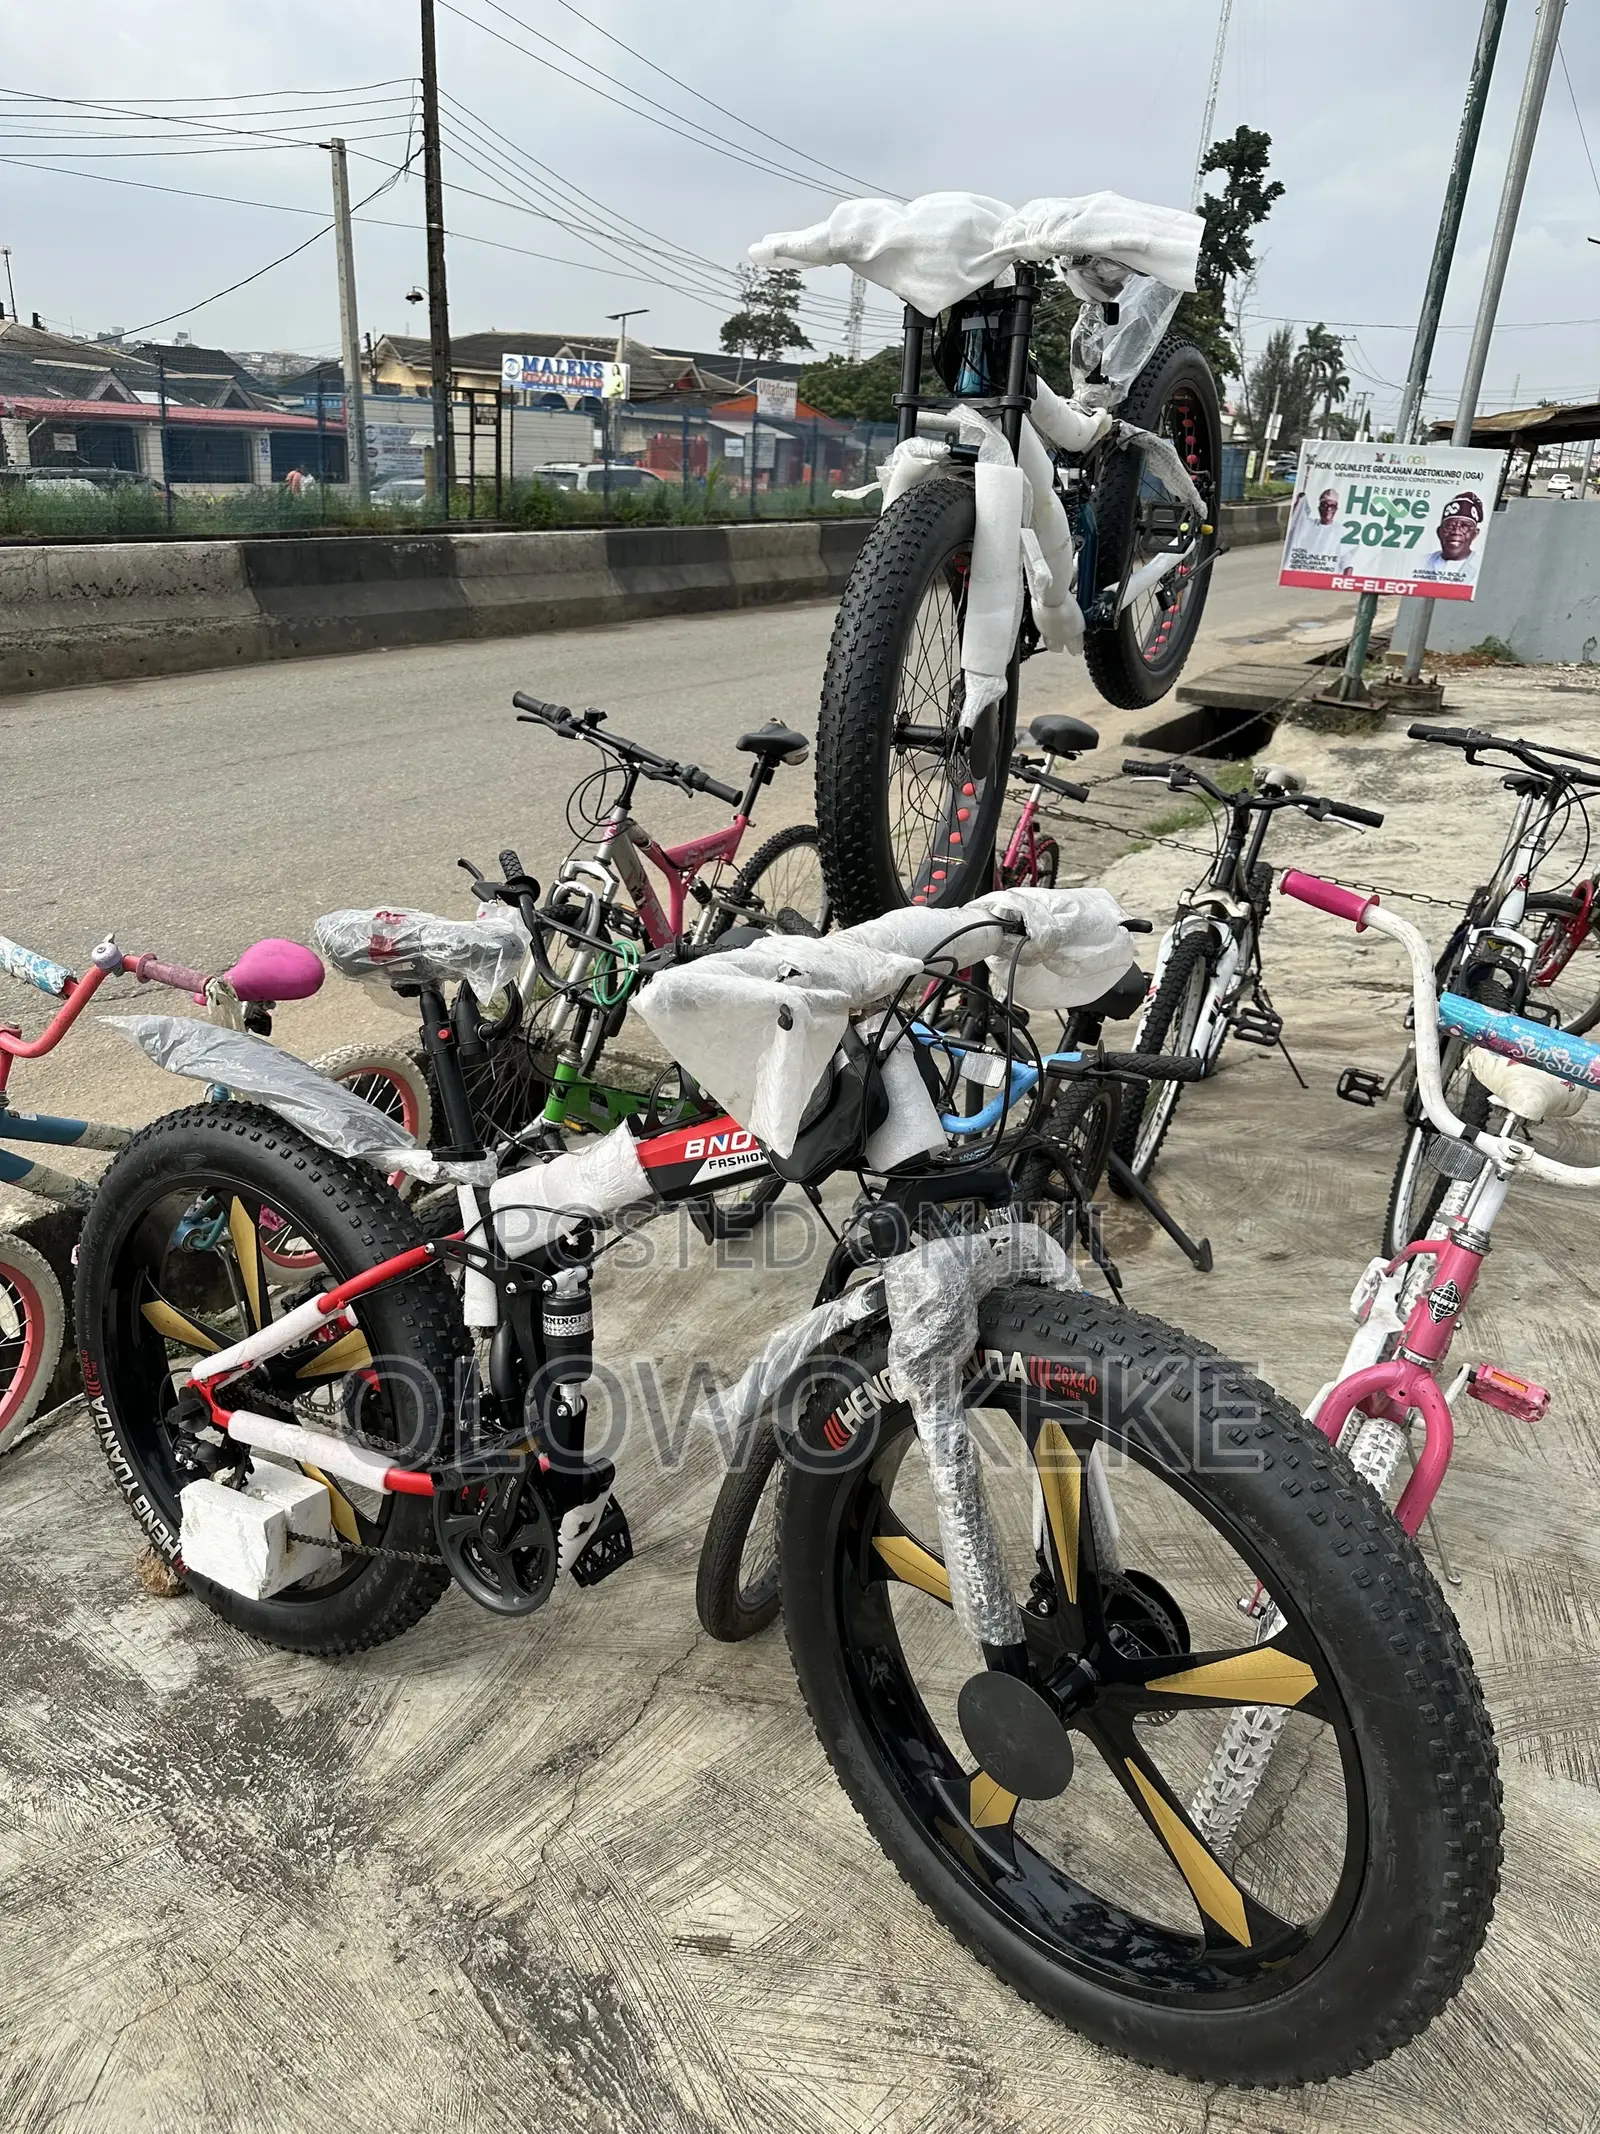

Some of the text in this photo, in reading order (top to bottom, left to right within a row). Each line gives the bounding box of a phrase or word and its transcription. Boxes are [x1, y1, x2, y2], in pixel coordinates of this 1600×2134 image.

[522, 356, 604, 379] MALENS
[1334, 463, 1372, 473] OGUNLEYE
[1373, 466, 1411, 476] GBOLAHAN
[1413, 468, 1461, 478] ADETOKUNBO
[1462, 471, 1484, 481] (OGA)
[1409, 477, 1454, 485] CONSTITUENCY
[1373, 486, 1431, 498] RENEWED
[1345, 485, 1430, 528] Hope
[1340, 520, 1425, 549] 2027
[1291, 552, 1339, 562] OGUNLEYE
[1331, 577, 1418, 594] RE-ELECT
[1054, 1363, 1098, 1395] 26X4.0
[1060, 1386, 1081, 1401] TIRE
[91, 1394, 140, 1498] YUANDA
[134, 1494, 182, 1560] HENG
